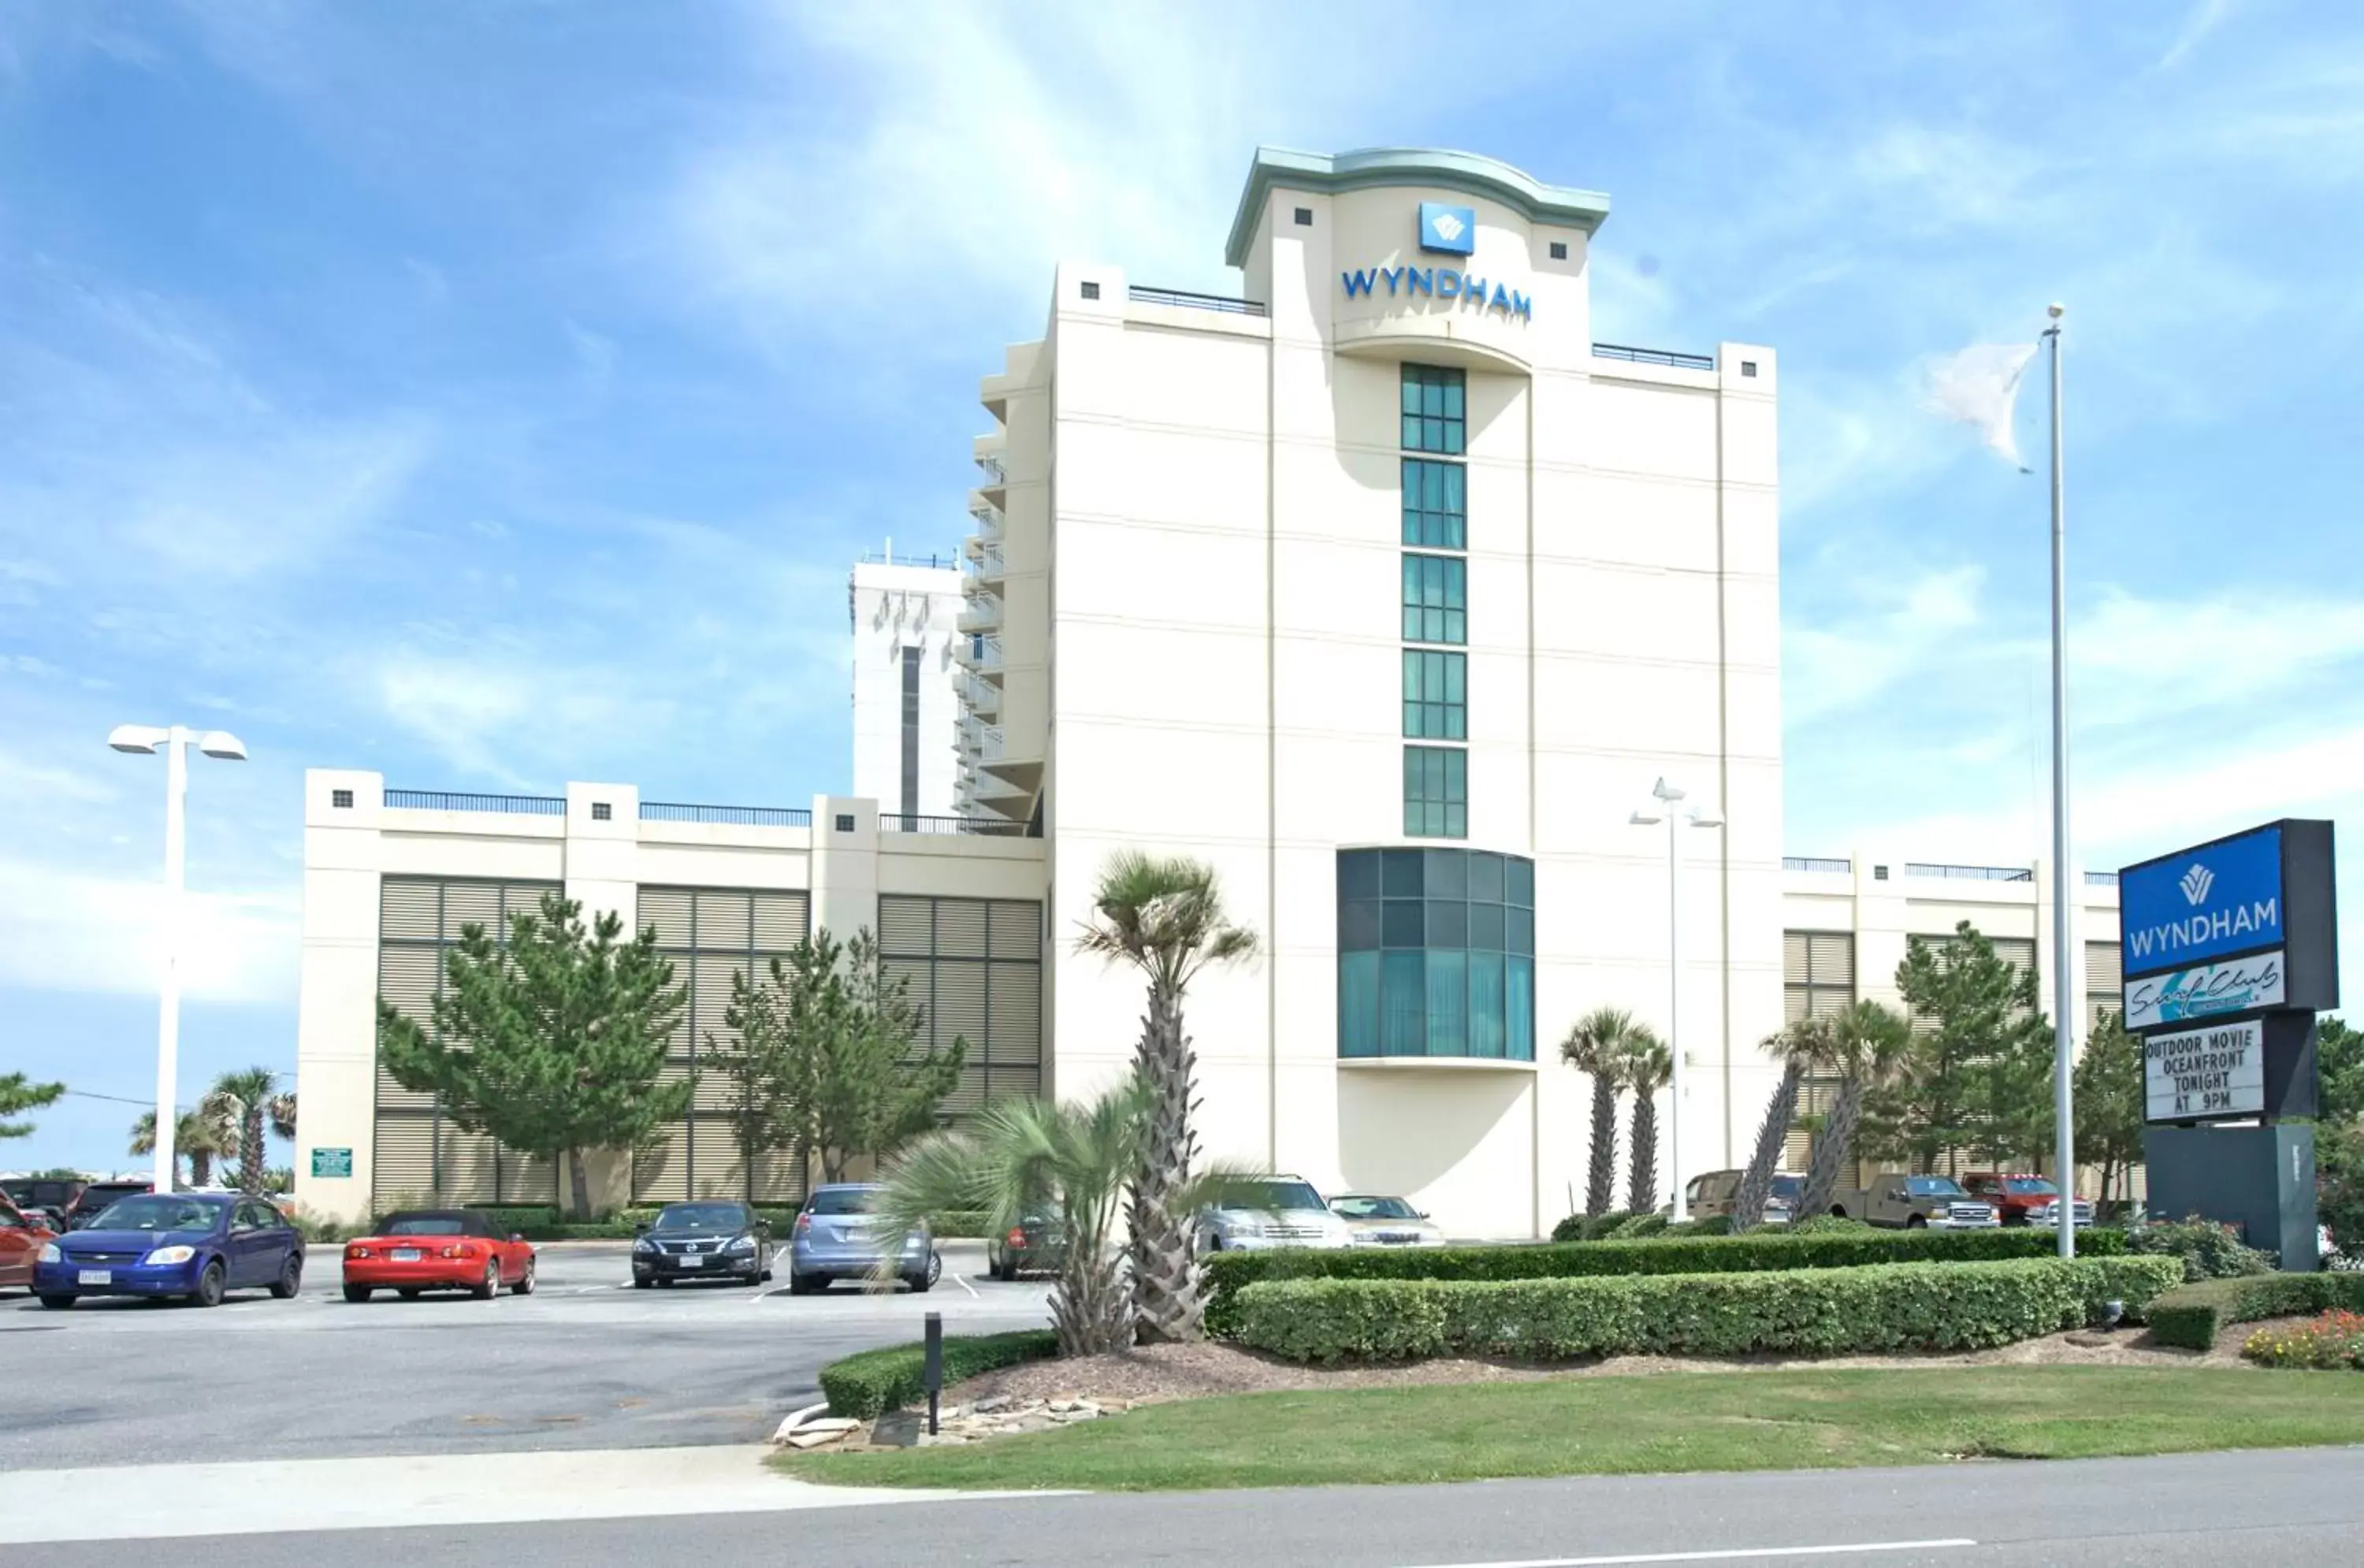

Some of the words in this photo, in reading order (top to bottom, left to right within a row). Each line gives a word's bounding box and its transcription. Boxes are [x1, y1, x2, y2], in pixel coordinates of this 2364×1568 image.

[1342, 266, 1531, 322] WYNDHAM
[2130, 897, 2276, 958] WYNDHAM
[2131, 975, 2204, 1017] Surf
[2206, 960, 2278, 997] Club
[2147, 1036, 2202, 1058] OUTDOOR
[2209, 1029, 2253, 1050] MOVIE
[2164, 1050, 2244, 1075] OCEANFRONT
[2174, 1072, 2229, 1092] TONIGHT
[2174, 1095, 2190, 1113] AT
[2203, 1091, 2231, 1109] 9PM
